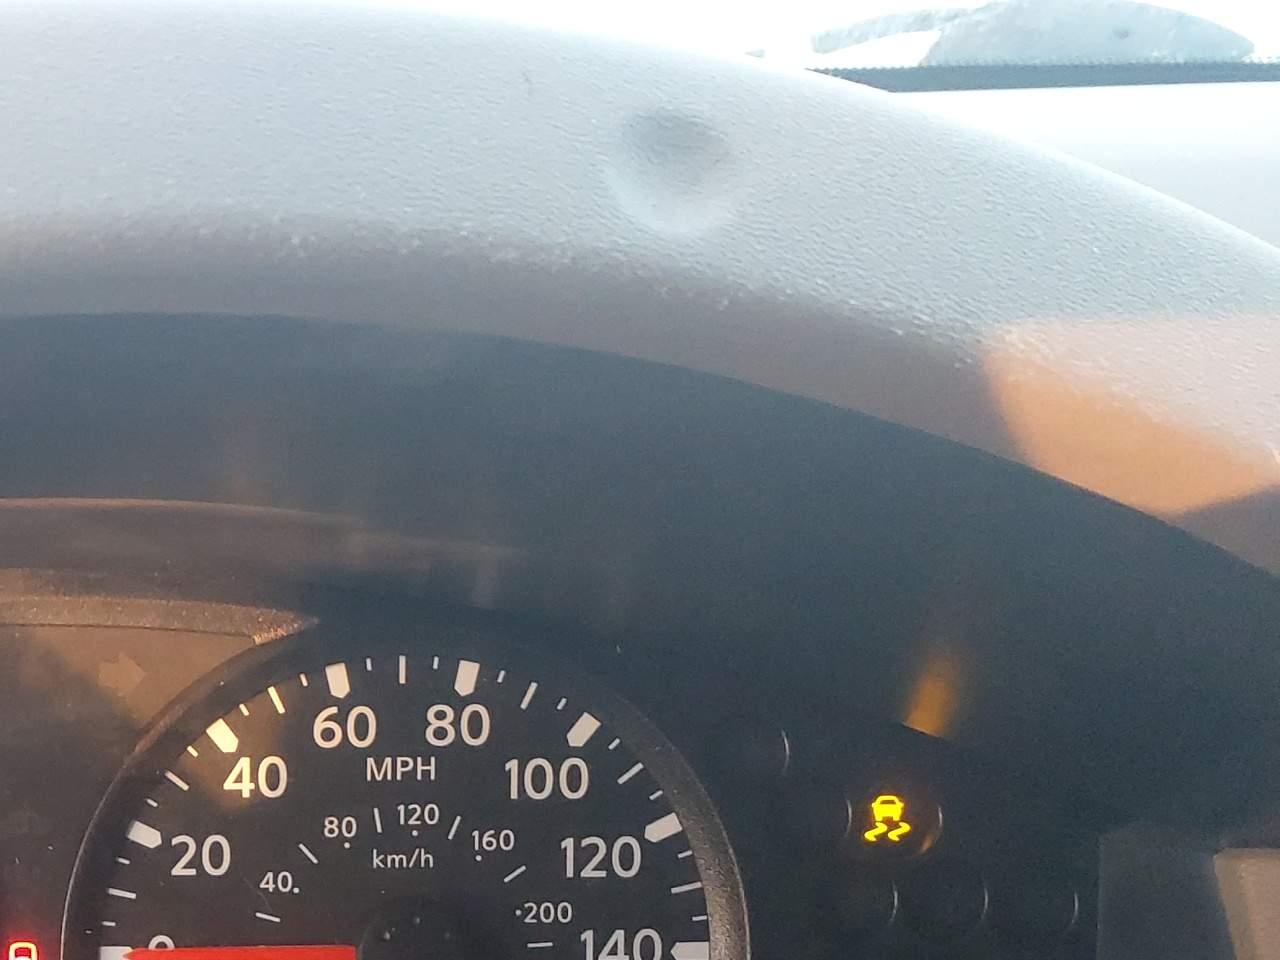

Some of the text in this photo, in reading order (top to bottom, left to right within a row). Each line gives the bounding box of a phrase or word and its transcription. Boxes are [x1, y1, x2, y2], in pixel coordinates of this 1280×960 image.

[314, 706, 376, 748] 60
[426, 704, 490, 746] 80
[224, 757, 287, 798] 40
[367, 757, 435, 781] MPH
[505, 758, 588, 799] 100
[324, 817, 356, 837] 80
[398, 804, 439, 824] 120
[171, 835, 230, 875] 20
[472, 830, 514, 850] 160
[373, 848, 433, 868] km/h
[561, 836, 641, 877] 120
[524, 902, 572, 923] 200
